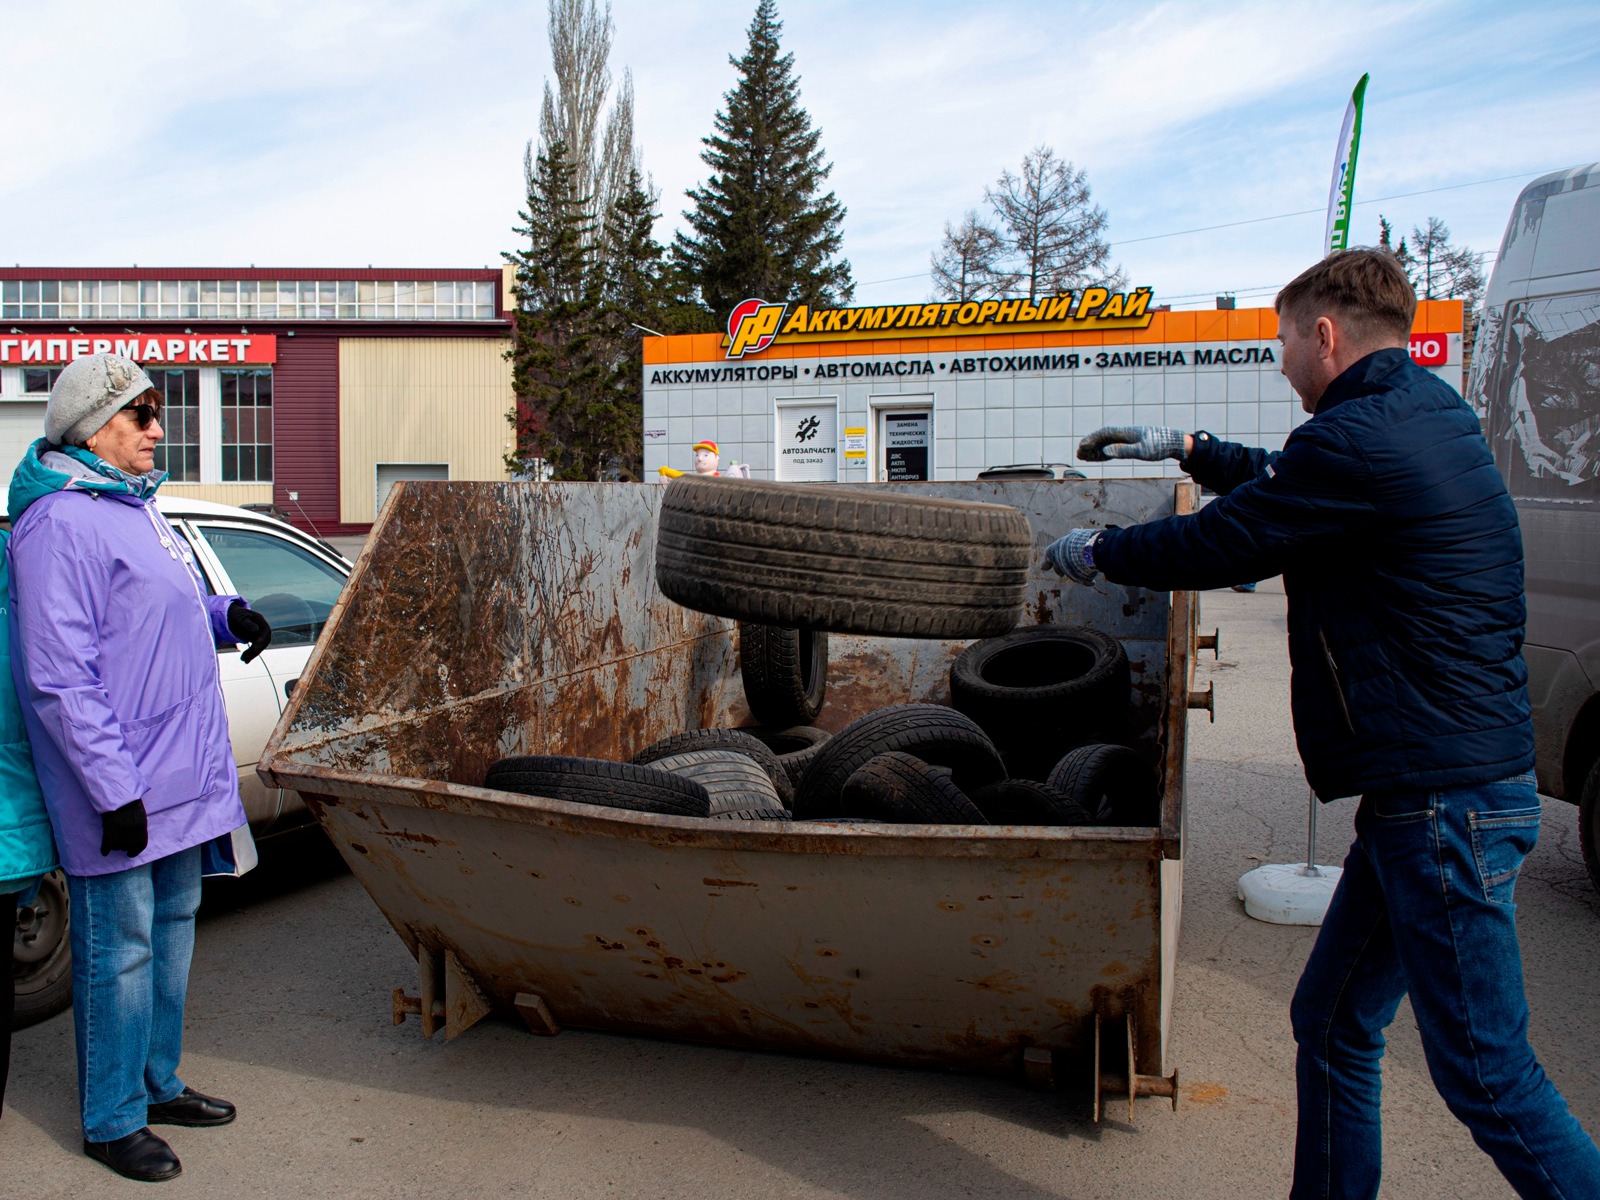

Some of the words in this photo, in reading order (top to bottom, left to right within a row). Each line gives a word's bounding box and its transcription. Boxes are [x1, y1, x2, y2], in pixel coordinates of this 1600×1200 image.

[781, 292, 1072, 333] АККУМУЛЯТОРНЫЙ
[1075, 287, 1152, 319] РАЙ
[1, 339, 251, 361] ГИПЕРМАРКЕТ
[1409, 340, 1441, 358] НО
[651, 365, 798, 384] АККУМУЛЯТОРЫ
[814, 360, 935, 378] АВТОМАСЛА
[949, 353, 1080, 373] АВТОХИМИЯ
[1095, 350, 1186, 368] ЗАМЕНА
[1194, 347, 1275, 365] МАСЛА
[782, 447, 836, 455] АВТОЗАПЧАСТИ
